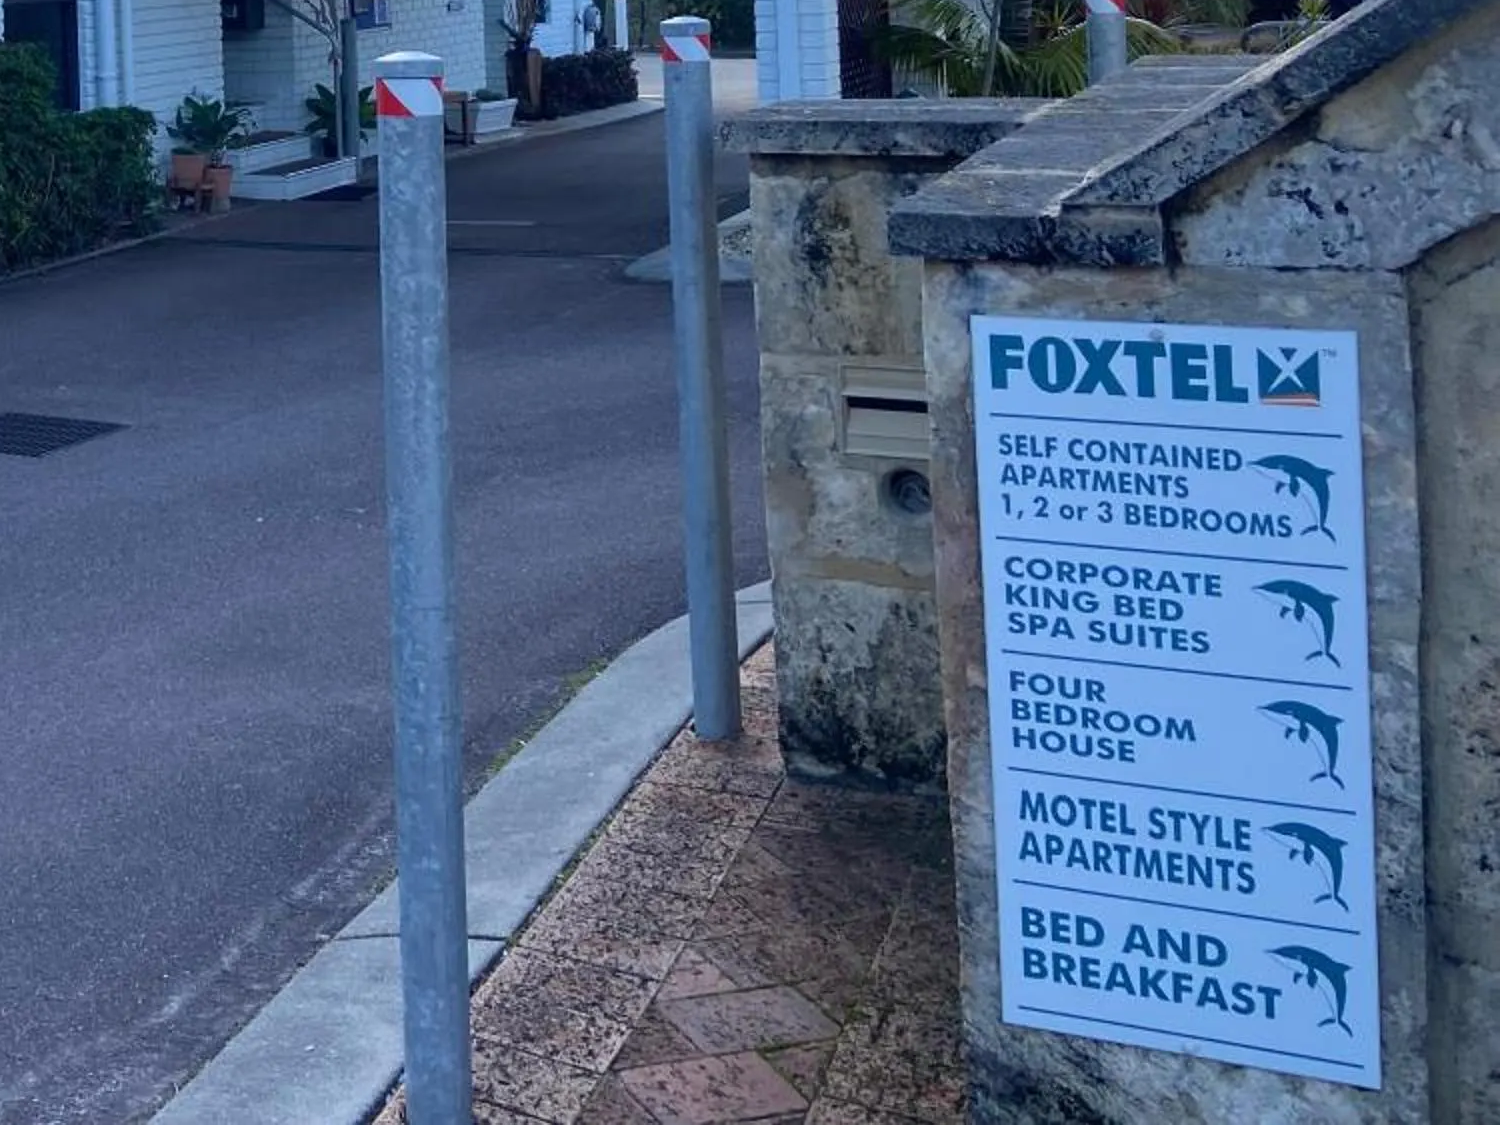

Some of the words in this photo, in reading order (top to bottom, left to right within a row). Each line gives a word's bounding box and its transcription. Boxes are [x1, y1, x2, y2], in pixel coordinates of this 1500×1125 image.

[988, 333, 1249, 404] FOXTEL
[999, 433, 1058, 458] SELF
[1068, 438, 1243, 472] CONTAINED
[1001, 464, 1189, 498] APARTMENTS
[1002, 494, 1024, 521] 1,
[1033, 496, 1049, 519] 2
[1059, 502, 1088, 523] or
[1098, 501, 1113, 524] 3
[1125, 503, 1292, 538] BEDROOMS
[1004, 556, 1223, 597] CORPORATE
[1005, 584, 1100, 614] KING
[1114, 593, 1184, 622] BED
[1008, 612, 1075, 640] SPA
[1089, 621, 1210, 654] SUITES
[1010, 670, 1106, 703] FOUR
[1011, 698, 1197, 742] BEDROOM
[1012, 728, 1136, 763] HOUSE
[1019, 789, 1137, 836] MOTEL
[1148, 807, 1252, 852] STYLE
[1019, 831, 1255, 895] APARTMENTS
[1021, 906, 1105, 948] BED
[1122, 924, 1228, 967] AND
[1022, 947, 1283, 1020] BREAKFAST
